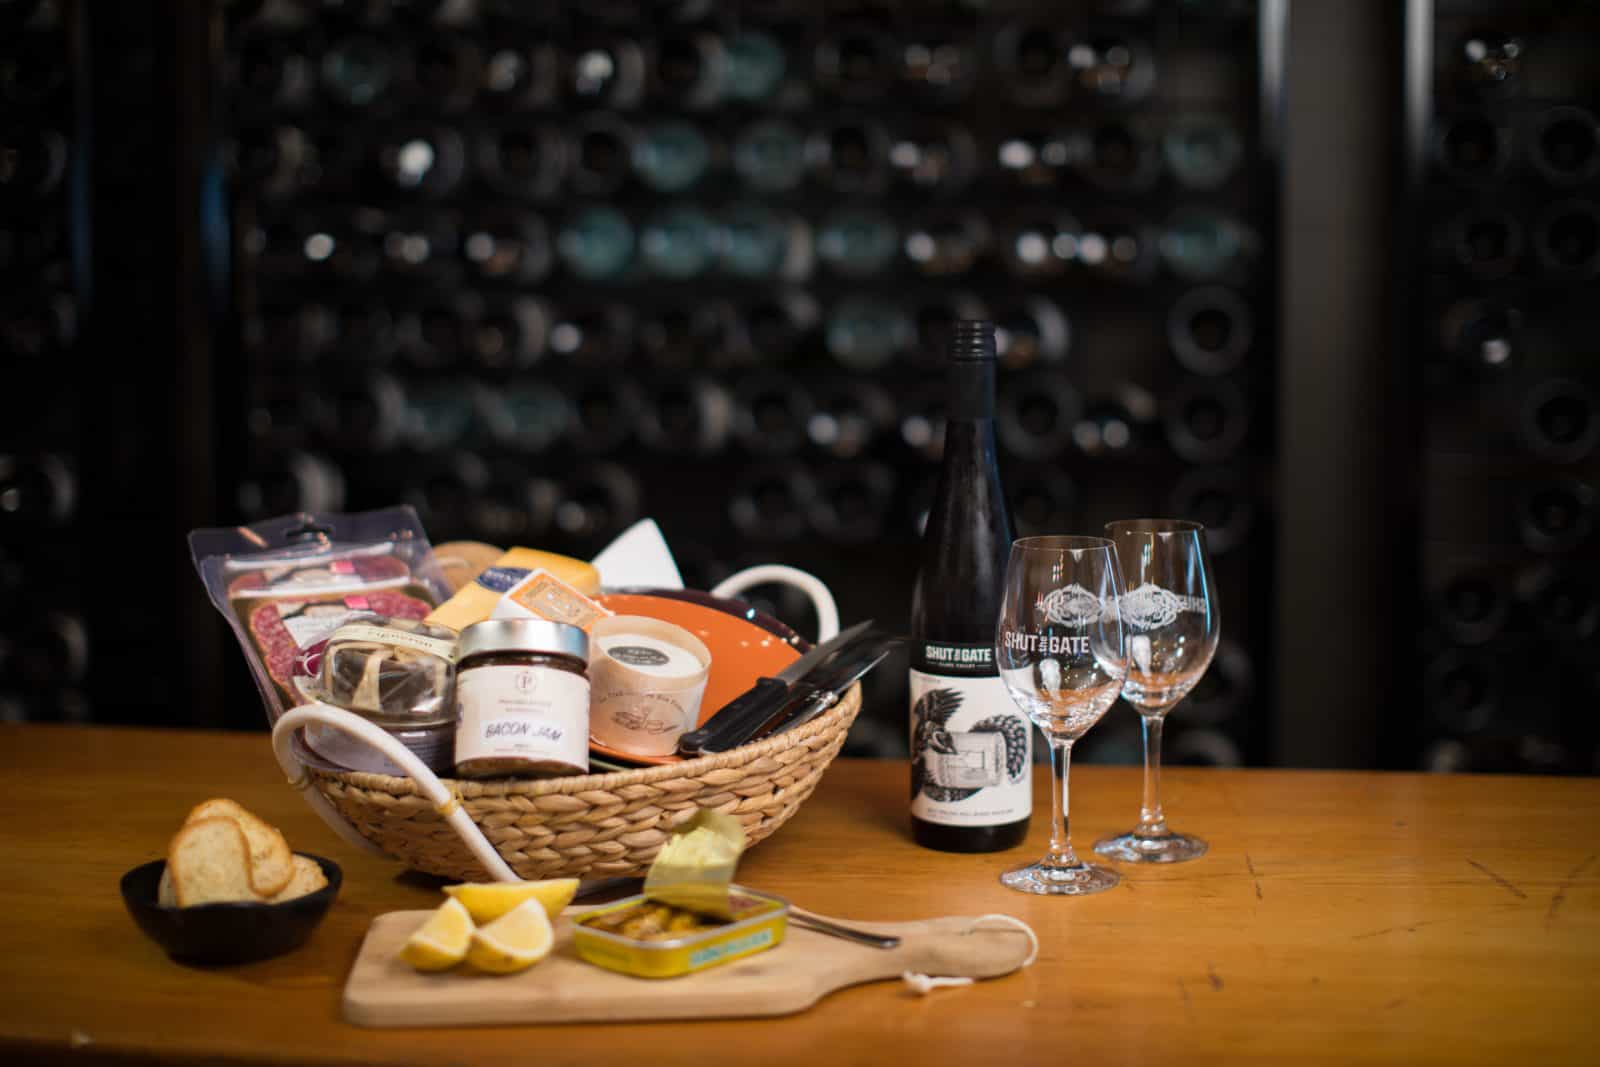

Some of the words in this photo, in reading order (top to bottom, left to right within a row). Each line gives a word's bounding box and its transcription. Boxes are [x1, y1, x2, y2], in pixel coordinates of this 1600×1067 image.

[1005, 631, 1038, 652] SHUT
[1049, 636, 1089, 654] GATE
[926, 645, 954, 660] SHUT
[961, 648, 992, 661] GATE
[484, 721, 531, 738] BACON
